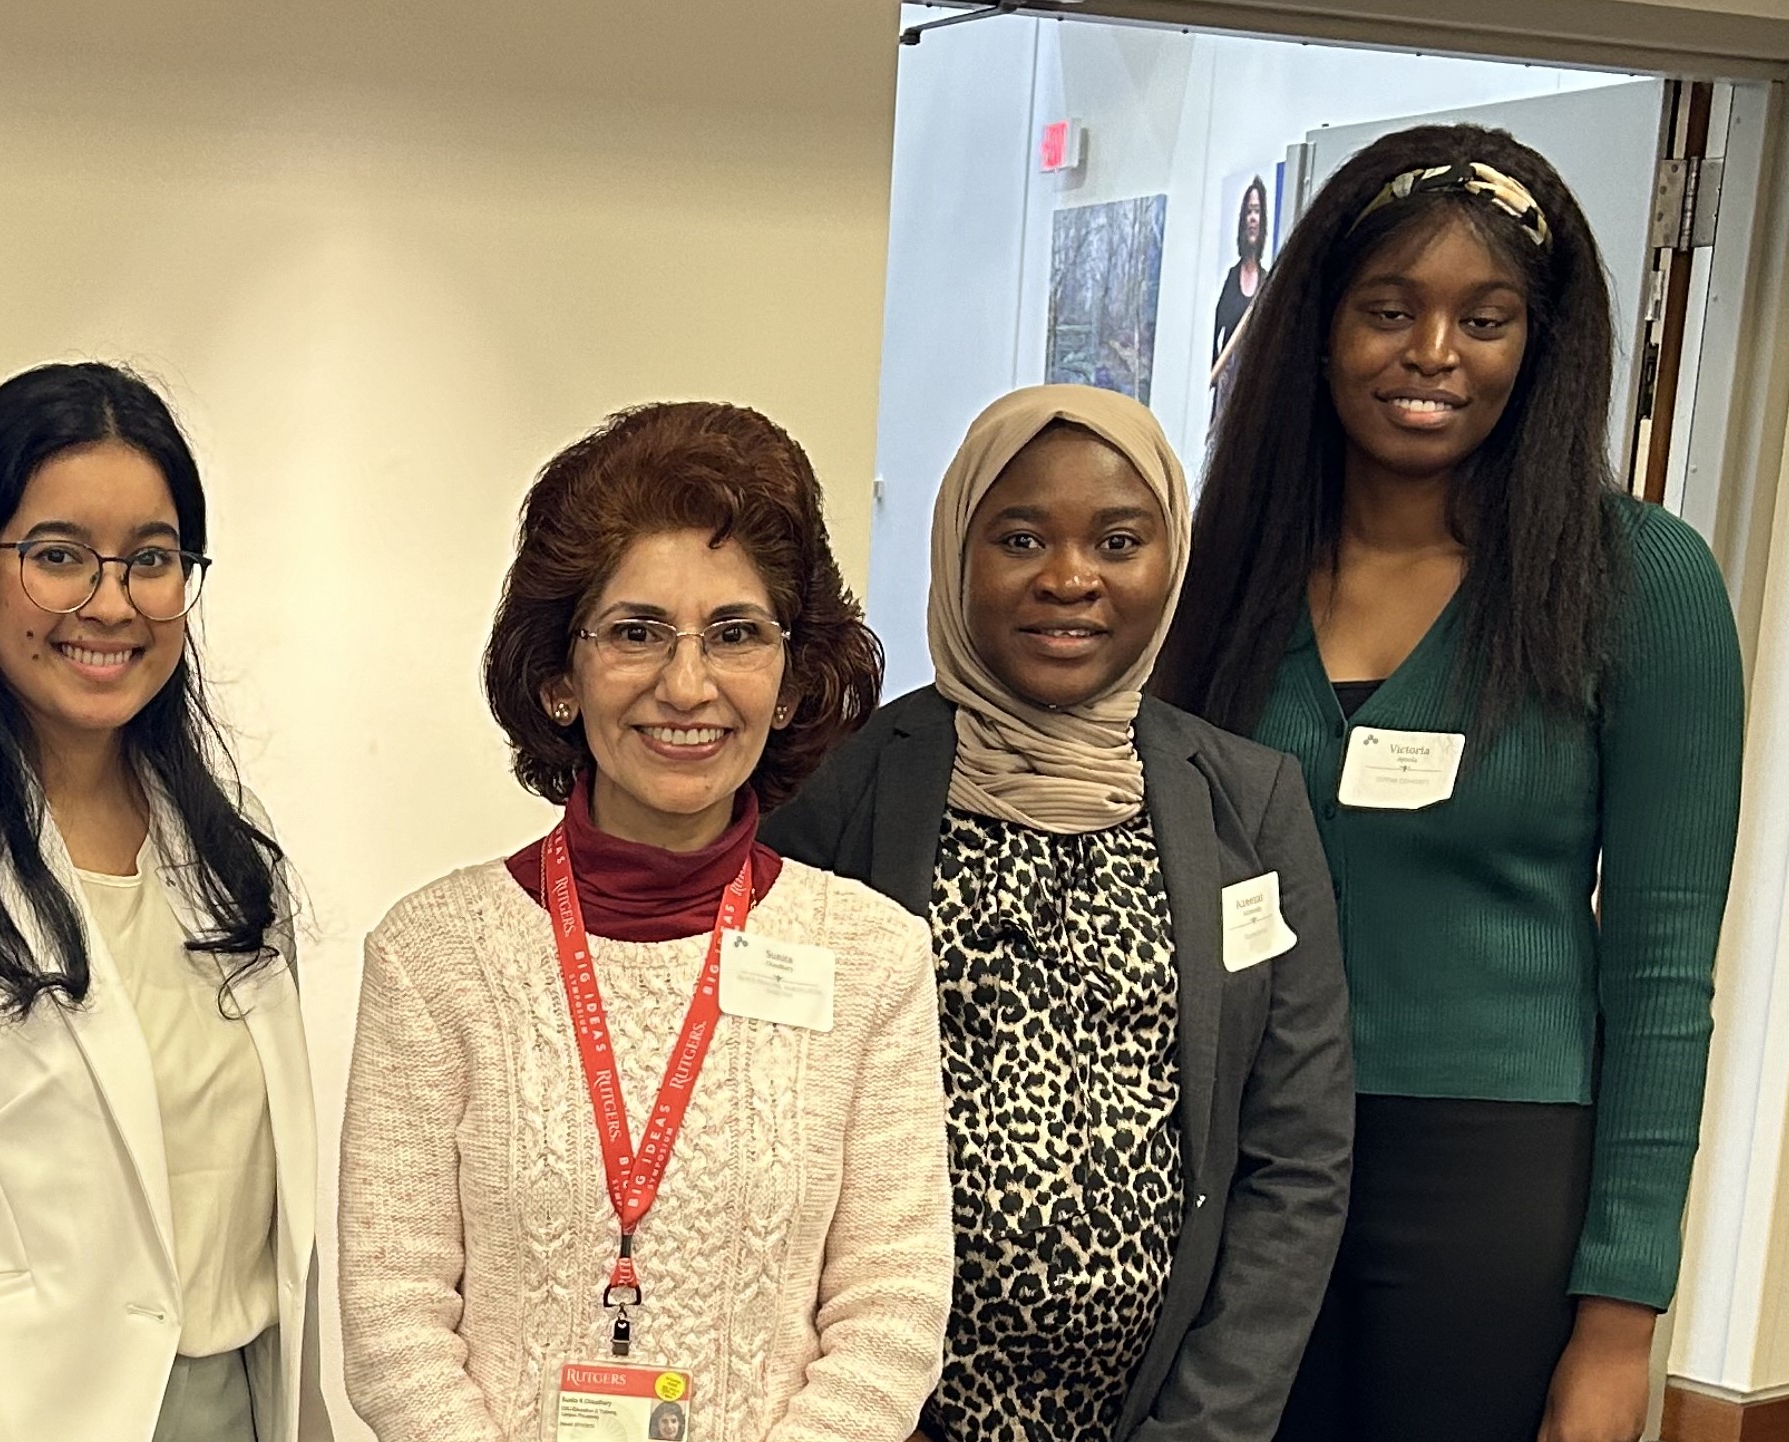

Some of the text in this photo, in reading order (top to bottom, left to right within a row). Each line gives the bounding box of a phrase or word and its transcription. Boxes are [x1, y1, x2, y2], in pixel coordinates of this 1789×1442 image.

[1389, 744, 1430, 755] Victoria
[552, 876, 576, 938] RUTGERS
[569, 973, 589, 1035] SYMPOSIUM
[574, 951, 607, 1052] BIG IDEAS
[702, 964, 720, 995] BIG
[668, 1021, 707, 1090] RUTGERS
[593, 1069, 622, 1143] RUTGERS
[627, 1104, 670, 1208] BIG IDEAS
[647, 1127, 674, 1190] SYMPOSIUM
[566, 1368, 627, 1386] RUTGERS
